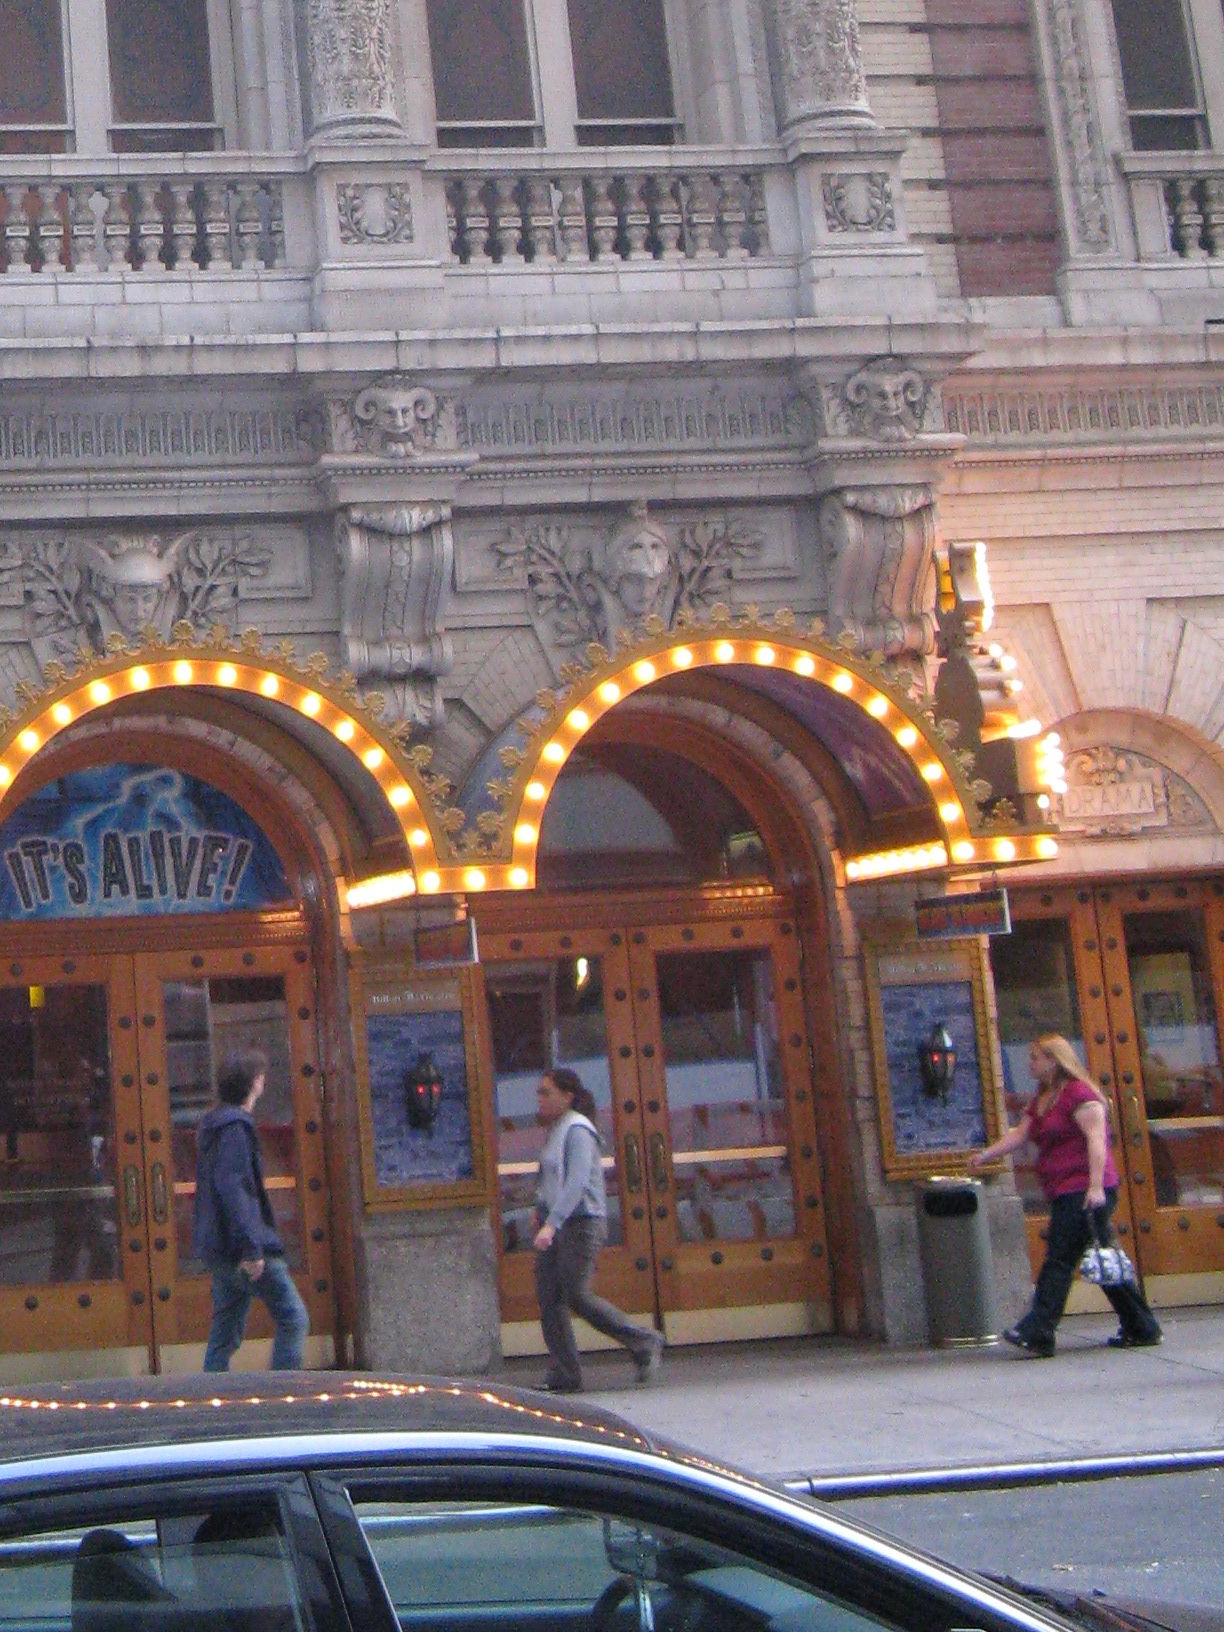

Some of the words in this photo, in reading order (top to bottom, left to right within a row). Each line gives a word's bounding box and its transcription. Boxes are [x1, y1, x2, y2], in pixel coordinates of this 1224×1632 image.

[1070, 784, 1153, 815] DRAMA
[5, 836, 89, 911] IT'S
[101, 828, 254, 904] ALIVE!
